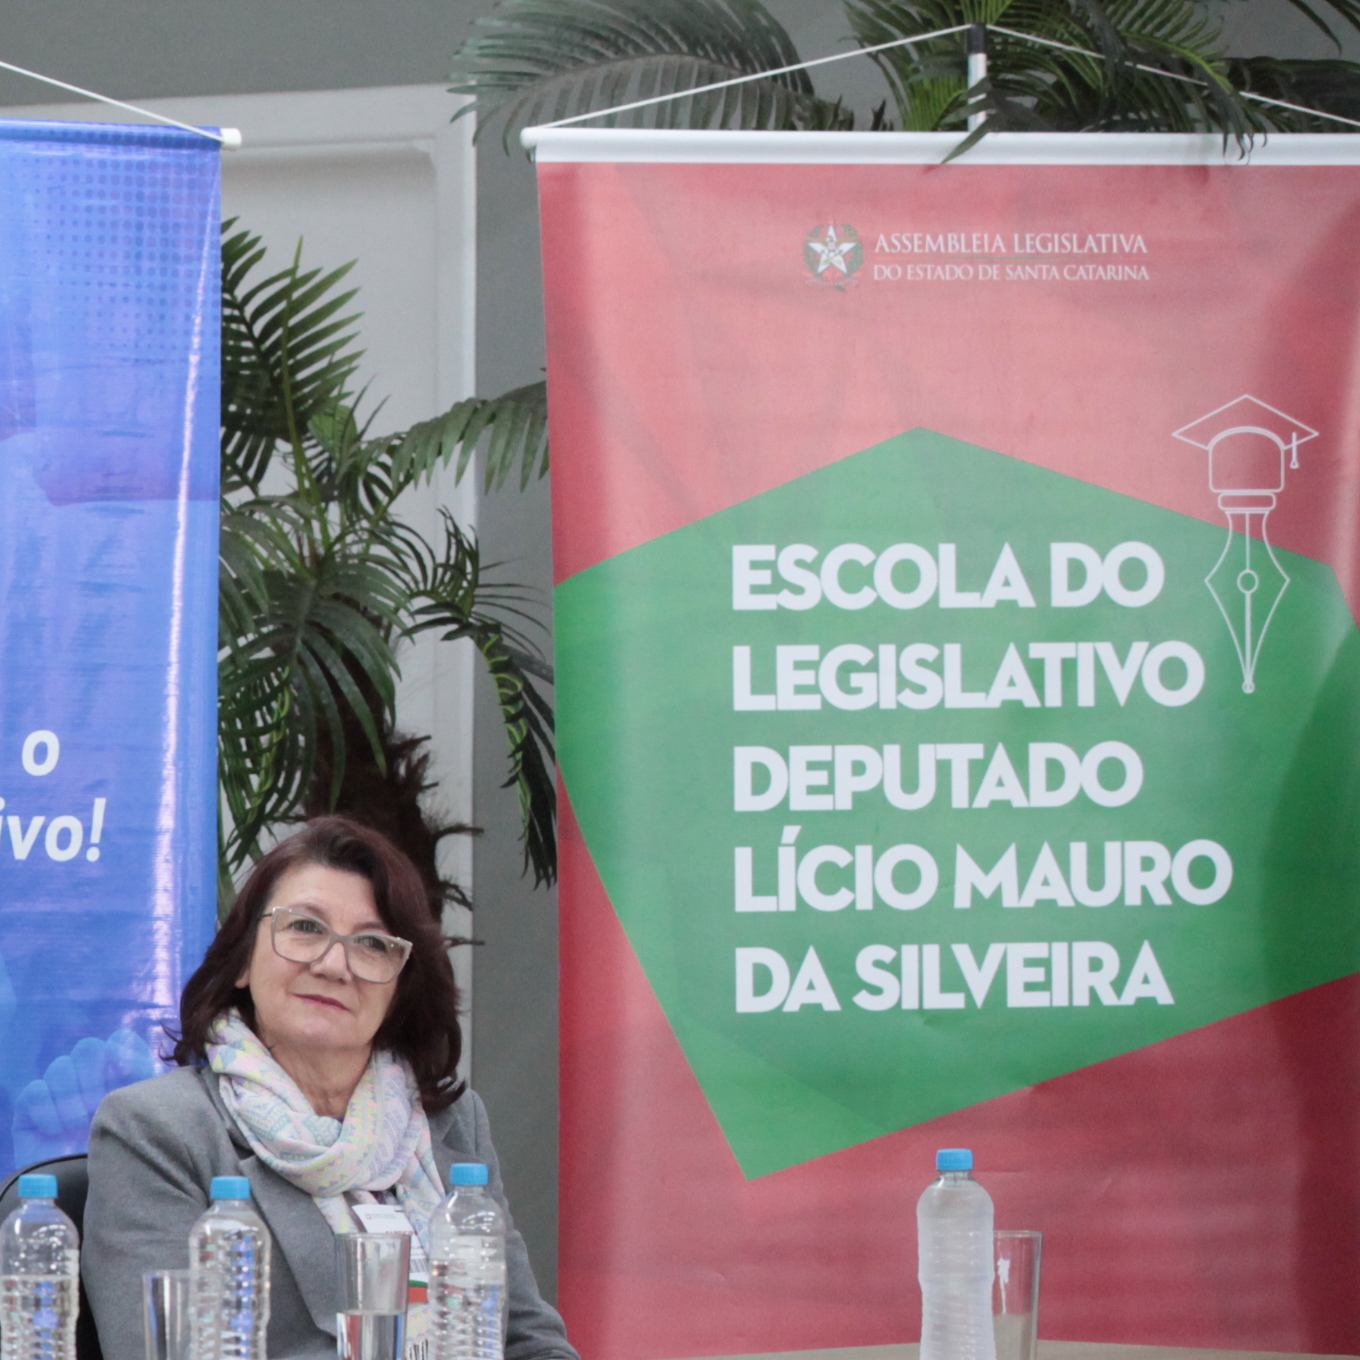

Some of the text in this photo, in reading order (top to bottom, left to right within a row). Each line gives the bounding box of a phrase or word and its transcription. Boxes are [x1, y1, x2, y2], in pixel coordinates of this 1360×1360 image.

[873, 264, 1150, 281] DO ESTADO DE SANTA CATARINA
[874, 232, 1149, 254] ASSEMBLEIA LEGISLATIVA
[732, 541, 1165, 611] ESCOLA DO
[732, 640, 1206, 711] LEGISLATIVO
[21, 729, 61, 777] o
[733, 740, 1144, 812] DEPUTADO
[734, 825, 1233, 912] LÍCIO MAURO
[735, 939, 1175, 1013] DA SILVEIRA
